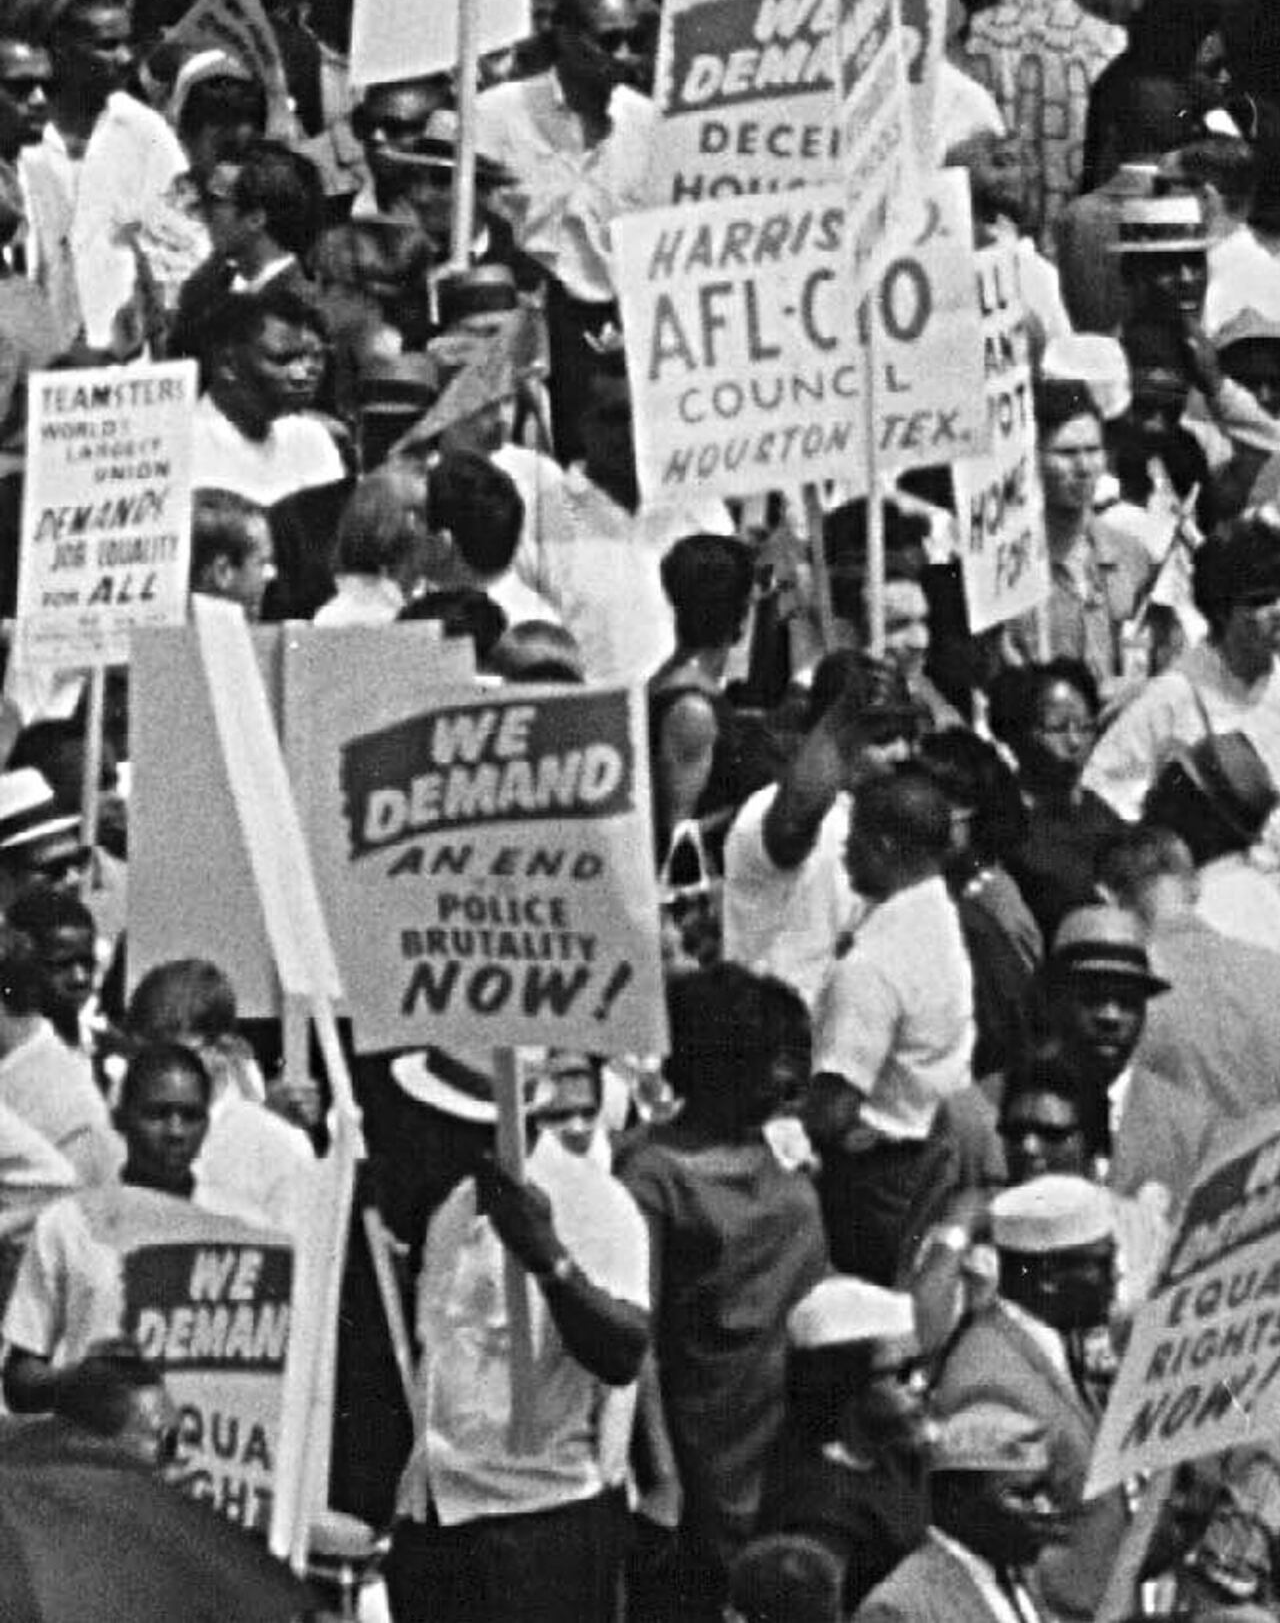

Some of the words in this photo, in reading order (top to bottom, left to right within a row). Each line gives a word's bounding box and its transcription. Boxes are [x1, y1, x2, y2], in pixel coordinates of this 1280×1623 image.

[649, 208, 845, 281] HARRIS
[42, 379, 185, 411] TEAMSTERS
[663, 421, 851, 483] HOUSTON
[880, 411, 971, 450] TEX.
[95, 462, 169, 482] UNION
[432, 709, 538, 763] WE
[366, 744, 622, 842] DEMAND
[389, 847, 473, 877] AN
[491, 851, 605, 881] END
[438, 893, 566, 924] POLICE
[402, 931, 596, 960] BRUTALITY
[402, 964, 633, 1019] NOW!
[190, 1251, 264, 1299] WE
